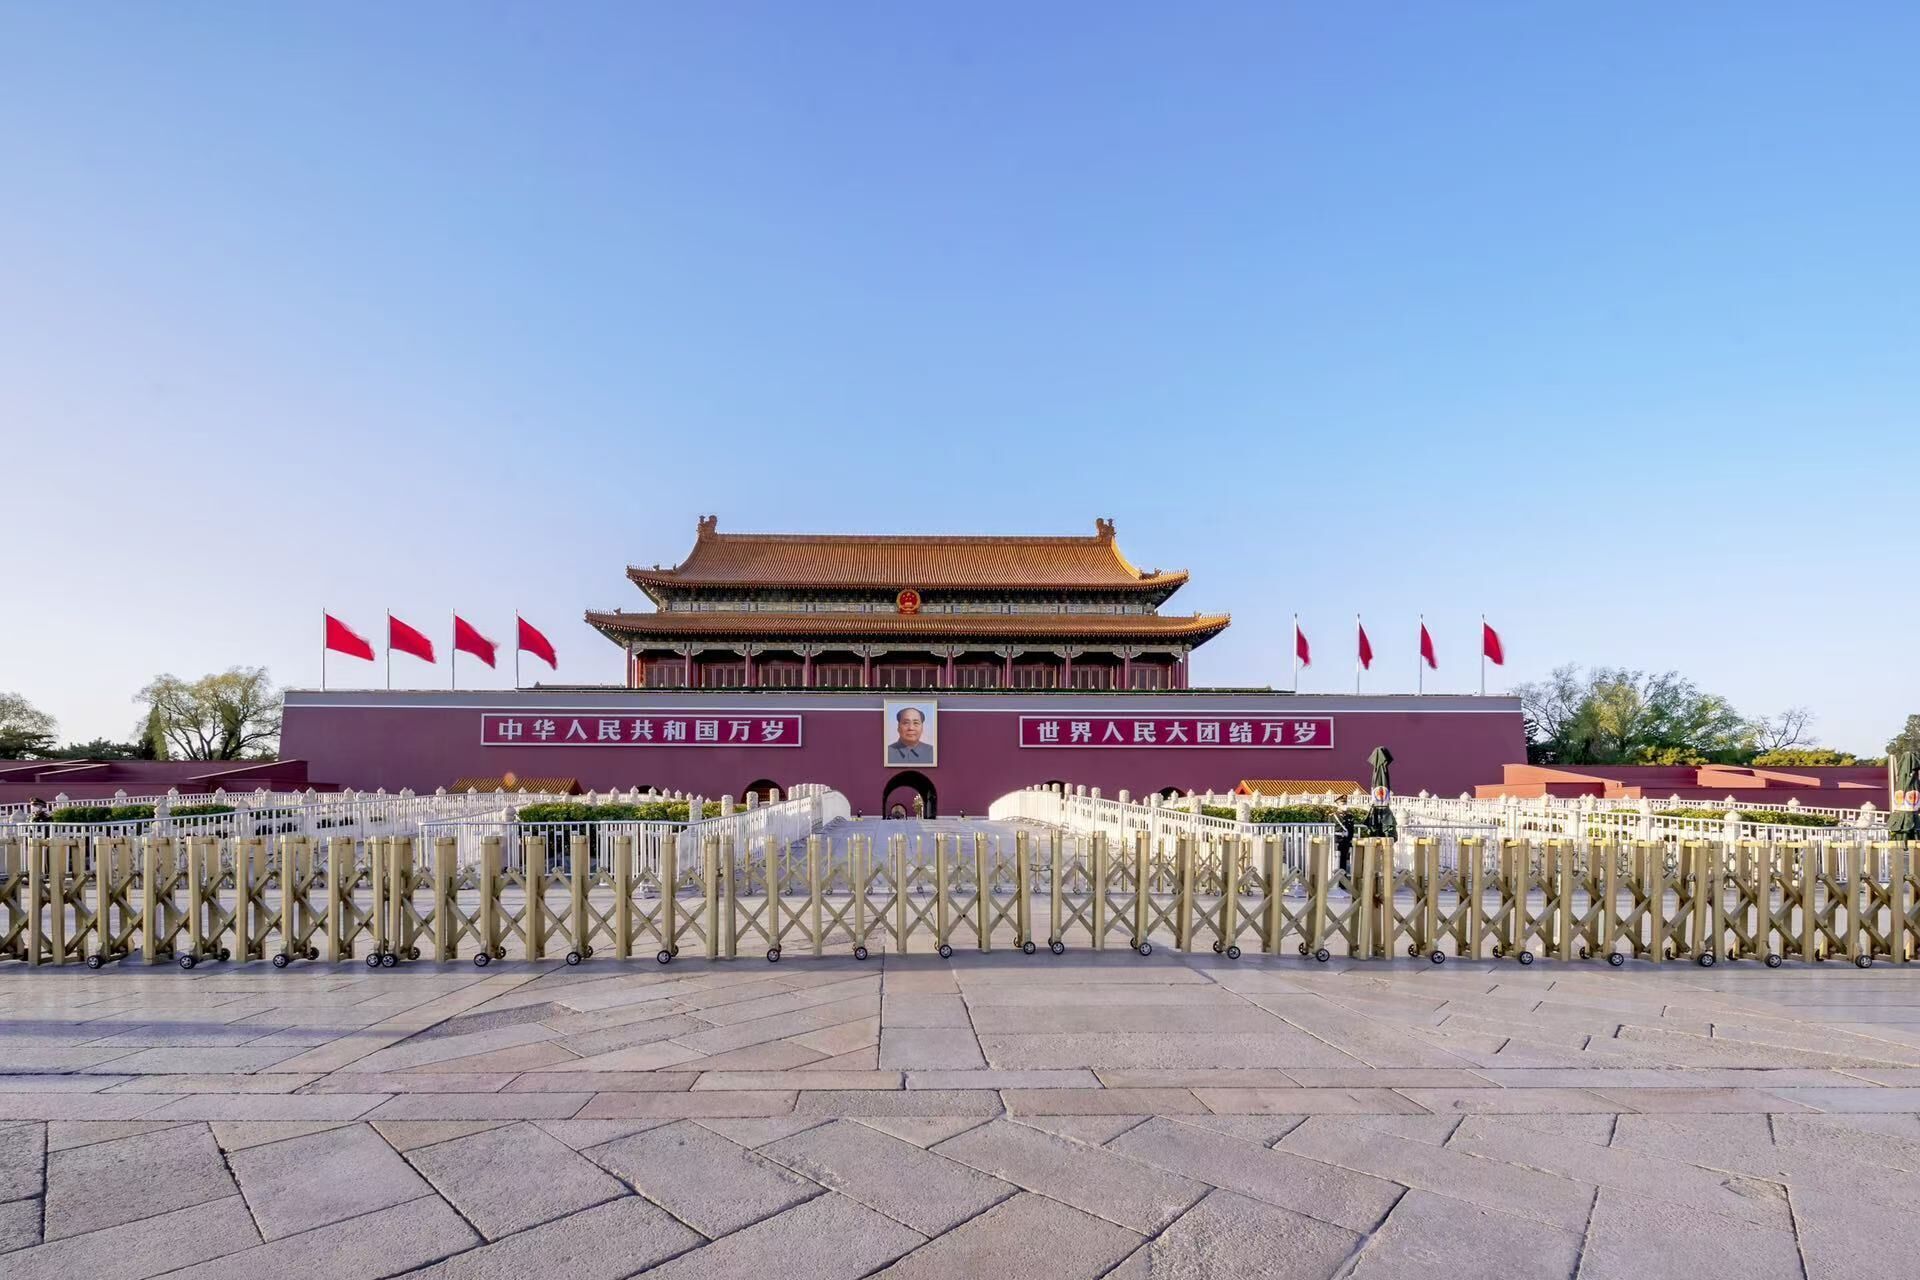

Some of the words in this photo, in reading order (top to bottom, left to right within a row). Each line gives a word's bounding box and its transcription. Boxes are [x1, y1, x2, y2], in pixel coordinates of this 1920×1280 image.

[498, 719, 784, 742] 中华人民共和国万岁
[1037, 721, 1318, 743] 世界人民大团结万岁
